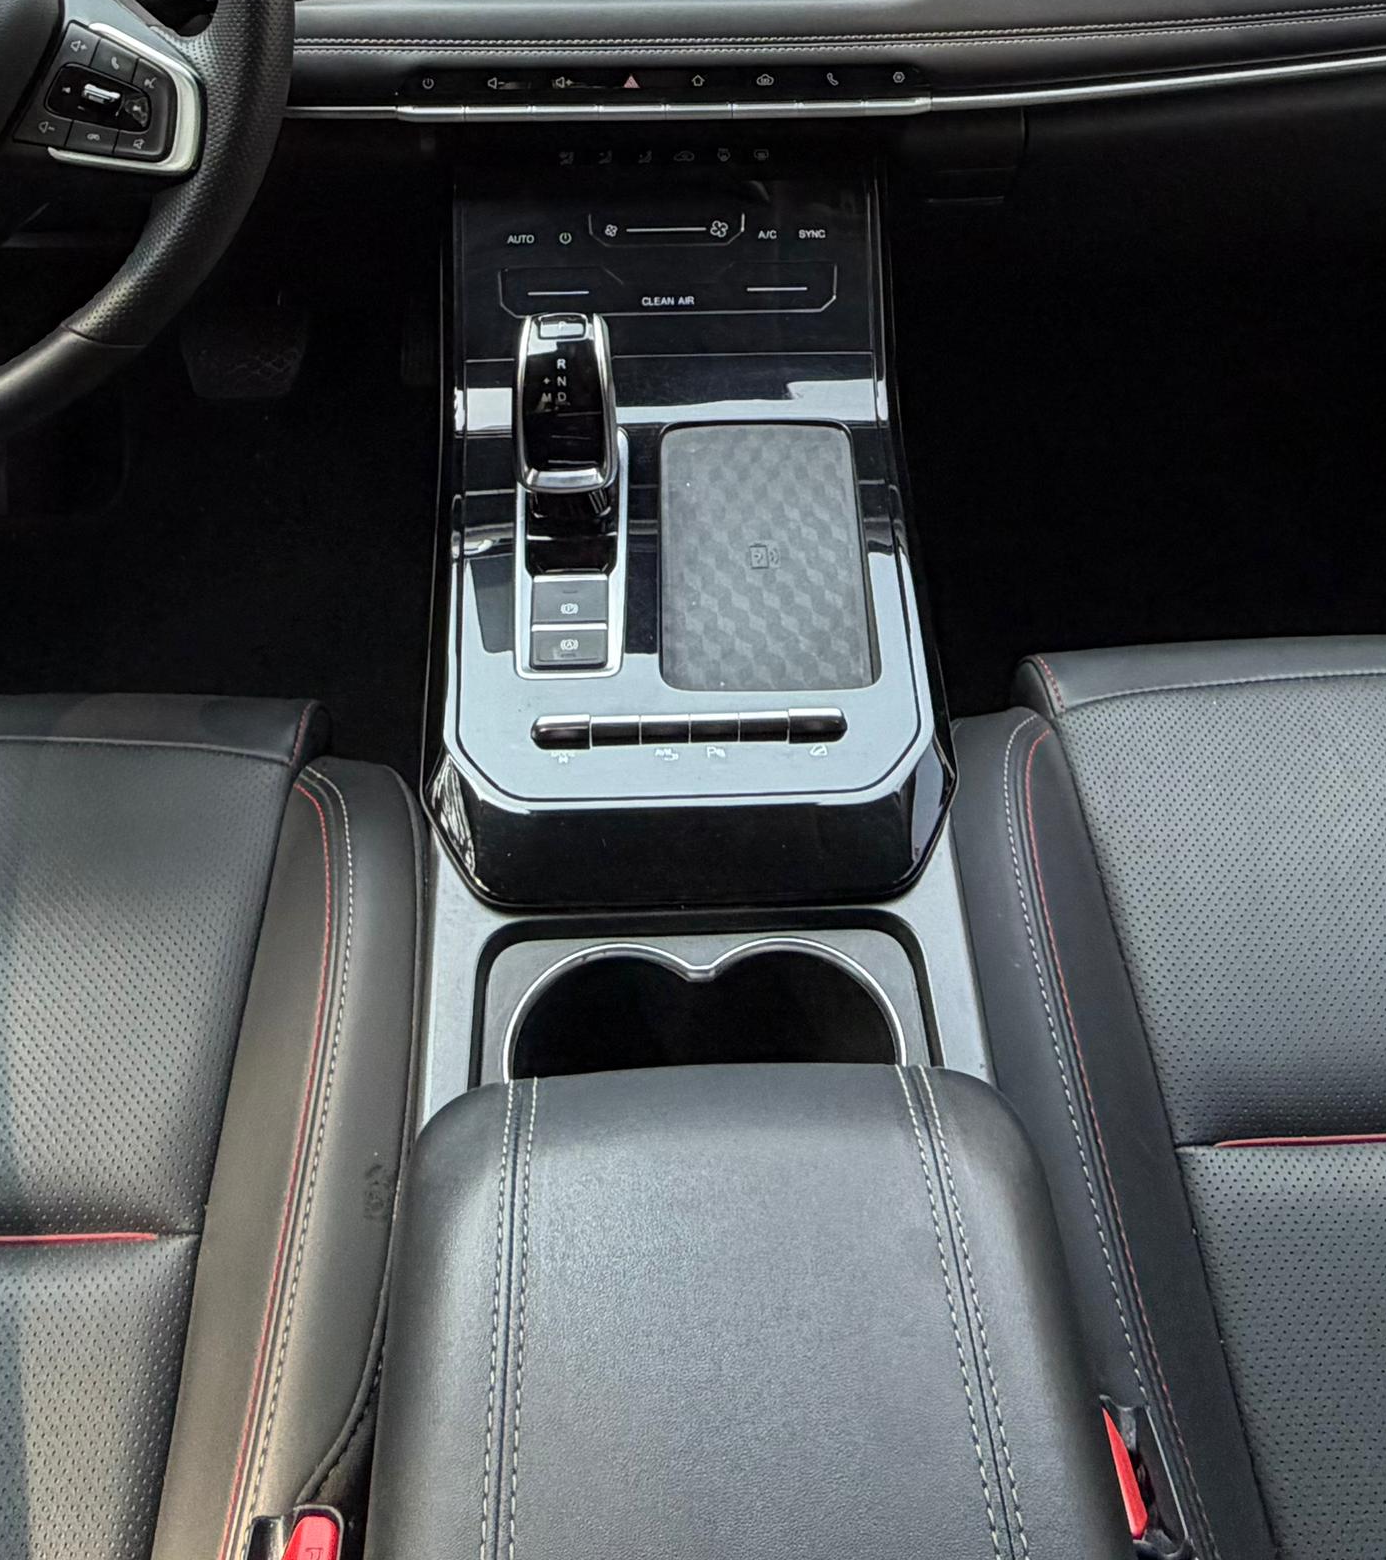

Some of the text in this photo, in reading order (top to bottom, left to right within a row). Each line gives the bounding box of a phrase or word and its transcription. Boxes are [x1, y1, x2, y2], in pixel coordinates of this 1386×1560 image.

[507, 233, 535, 244] AUTO
[758, 230, 777, 240] A/C
[799, 229, 826, 240] SYNC
[641, 295, 695, 307] CLEAN AIR
[557, 358, 567, 370] R
[556, 375, 567, 387] N
[557, 391, 567, 403] D
